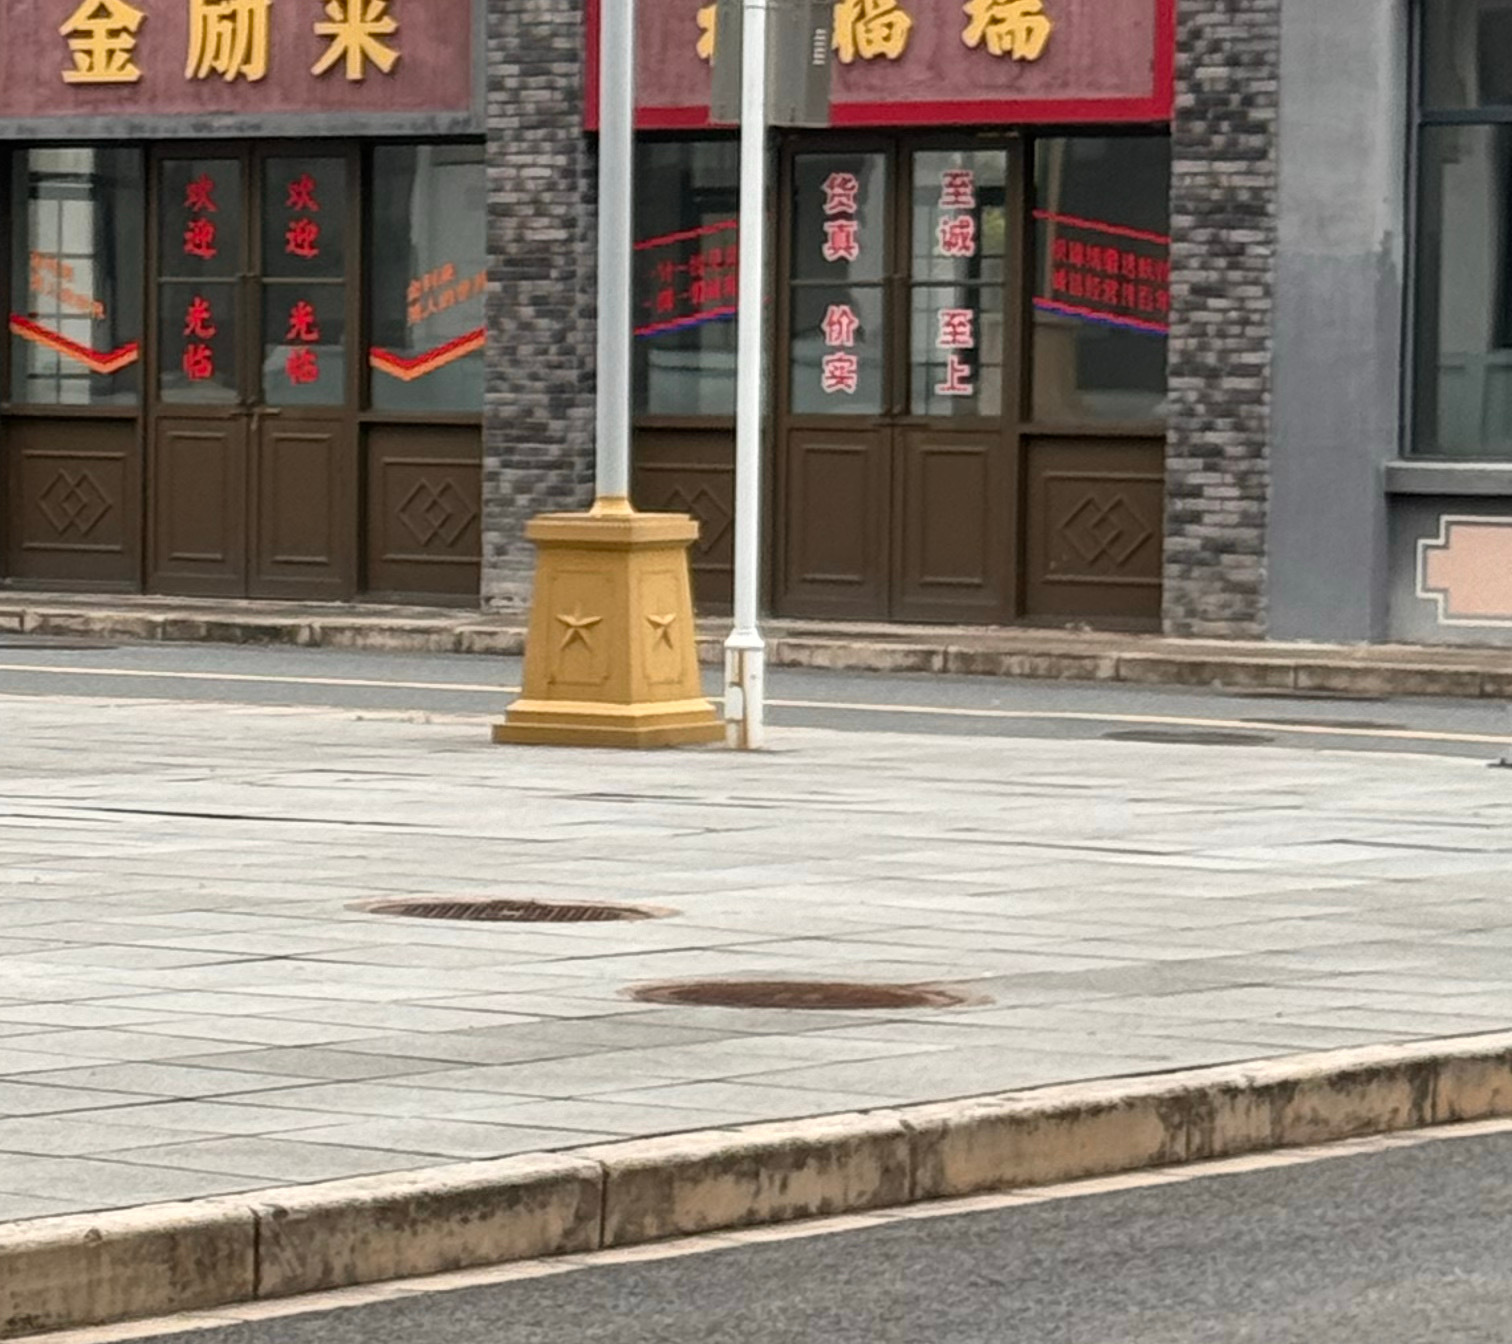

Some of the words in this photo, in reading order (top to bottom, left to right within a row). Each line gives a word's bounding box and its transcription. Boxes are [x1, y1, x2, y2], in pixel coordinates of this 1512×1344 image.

[181, 173, 218, 382] 欢迎光临
[284, 174, 320, 387] 欢迎光临
[822, 172, 860, 394] 货真价实
[935, 169, 975, 396] 至诚至上
